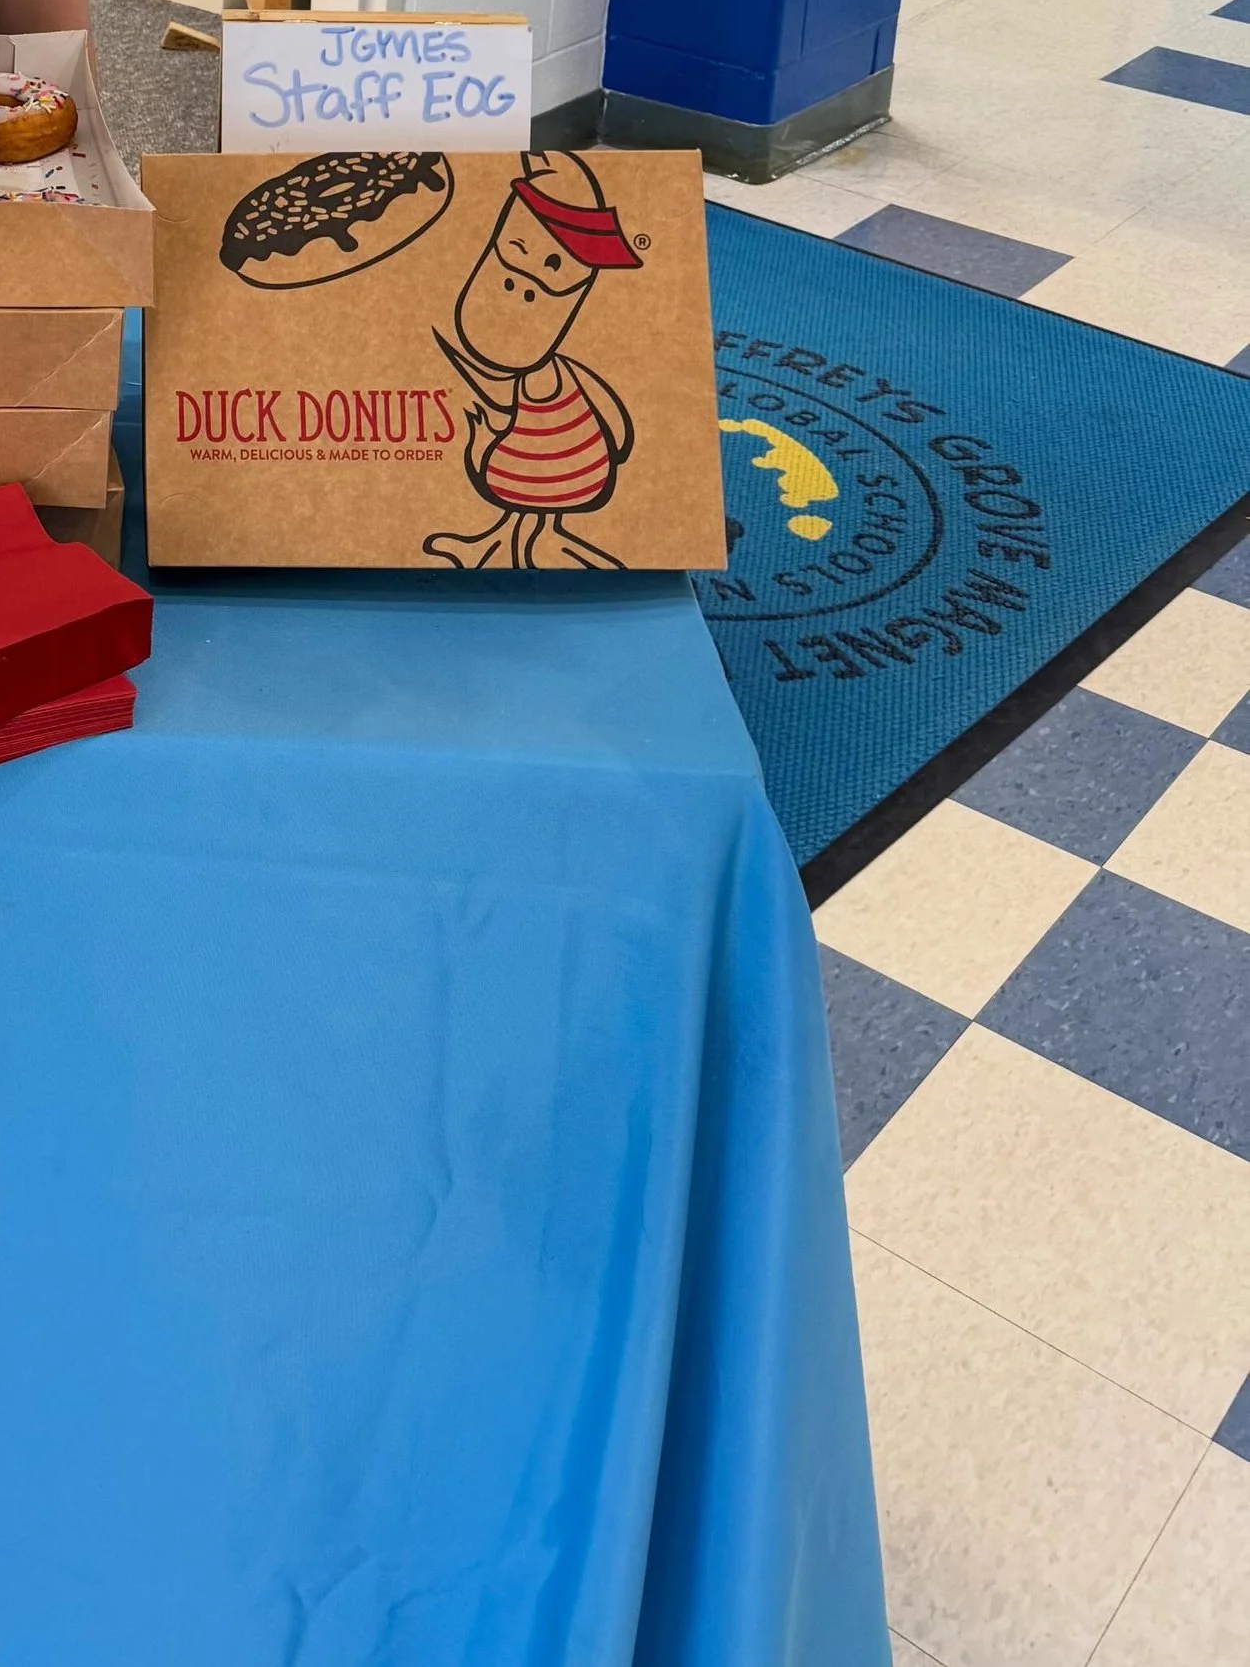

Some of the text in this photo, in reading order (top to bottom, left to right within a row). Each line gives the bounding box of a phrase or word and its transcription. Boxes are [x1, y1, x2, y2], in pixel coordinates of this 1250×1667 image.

[243, 61, 516, 128] Staff EOG
[175, 388, 456, 444] DUCK DONUTS
[190, 448, 444, 462] WARM, DELICIOUS & MADE TO ORDER
[773, 473, 907, 596] SCHOOLS
[928, 434, 1052, 570] GROVE
[762, 567, 1029, 682] MAGNET
